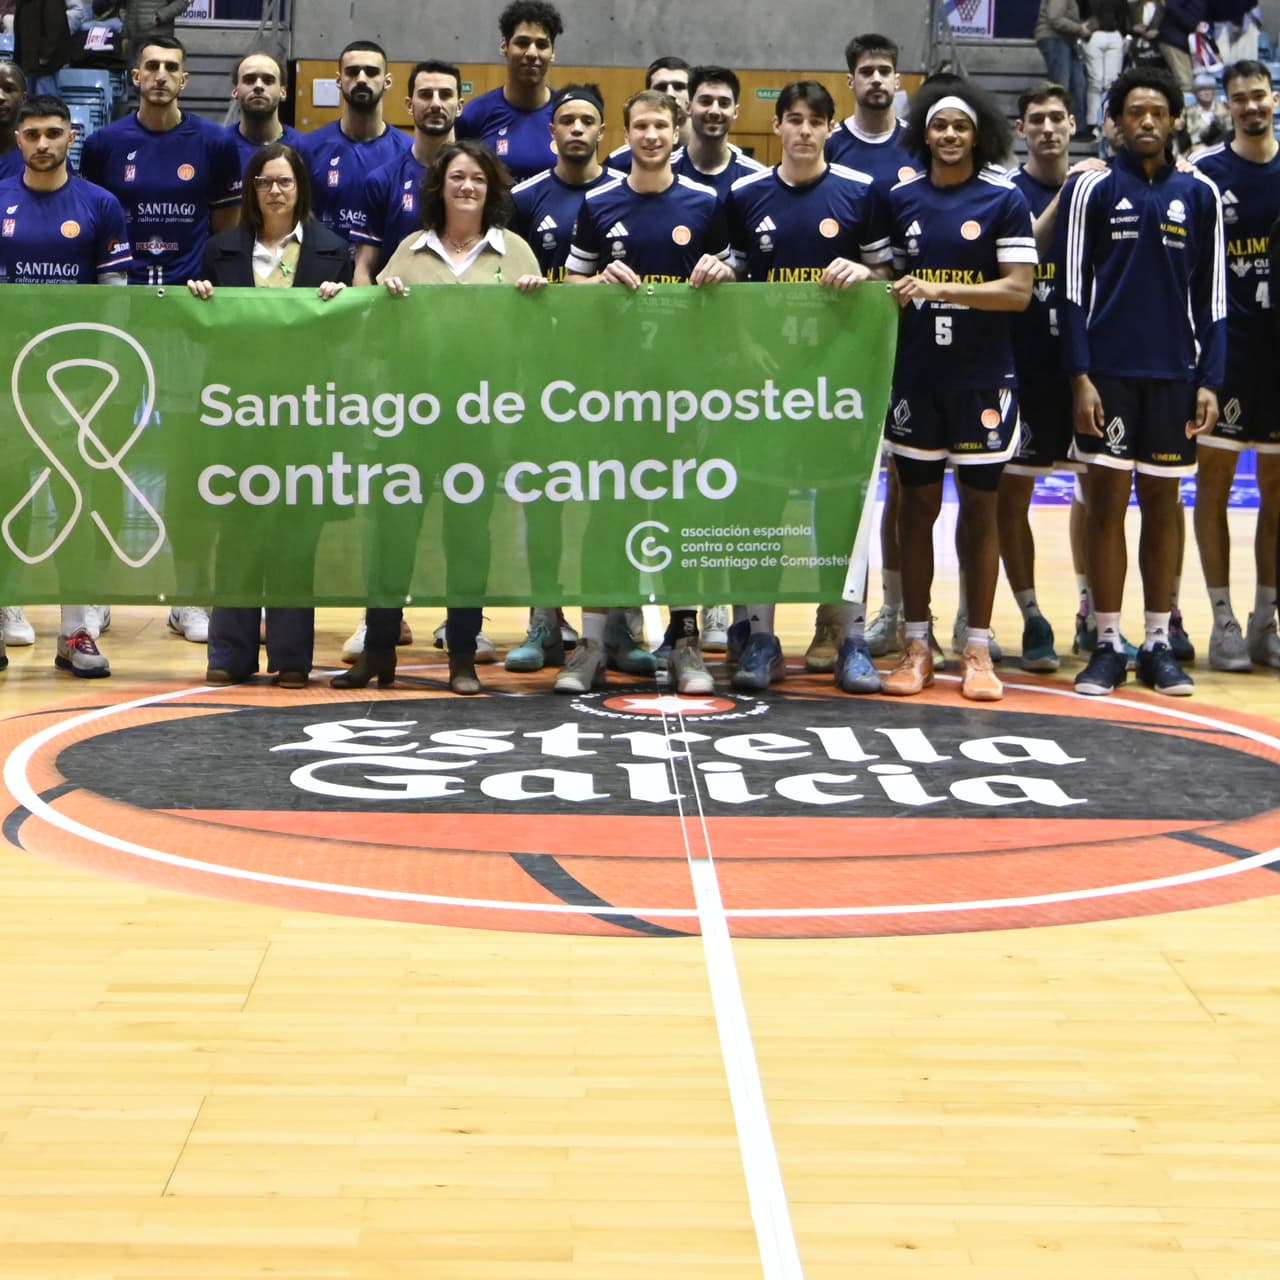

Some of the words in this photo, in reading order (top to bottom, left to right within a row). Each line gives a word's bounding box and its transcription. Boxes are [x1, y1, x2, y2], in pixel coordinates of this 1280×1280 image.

[137, 202, 196, 216] SANTIAGO
[1226, 236, 1270, 256] ALIM
[15, 262, 80, 277] SANTIAGO
[935, 316, 953, 346] 5
[199, 382, 440, 438] Santiago
[456, 381, 525, 425] de
[540, 378, 864, 433] Compostela
[198, 451, 423, 506] contra
[442, 461, 484, 505] o
[505, 457, 738, 502] cancro
[681, 524, 750, 537] asociación
[753, 524, 812, 539] española
[681, 541, 723, 553] contra
[725, 542, 734, 552] o
[737, 541, 781, 552] cancro
[681, 558, 698, 569] en
[699, 555, 758, 570] Santiago
[760, 555, 777, 568] de
[779, 554, 850, 569] Compostel
[269, 717, 1088, 766] Estrella
[280, 753, 1088, 807] Galicia
